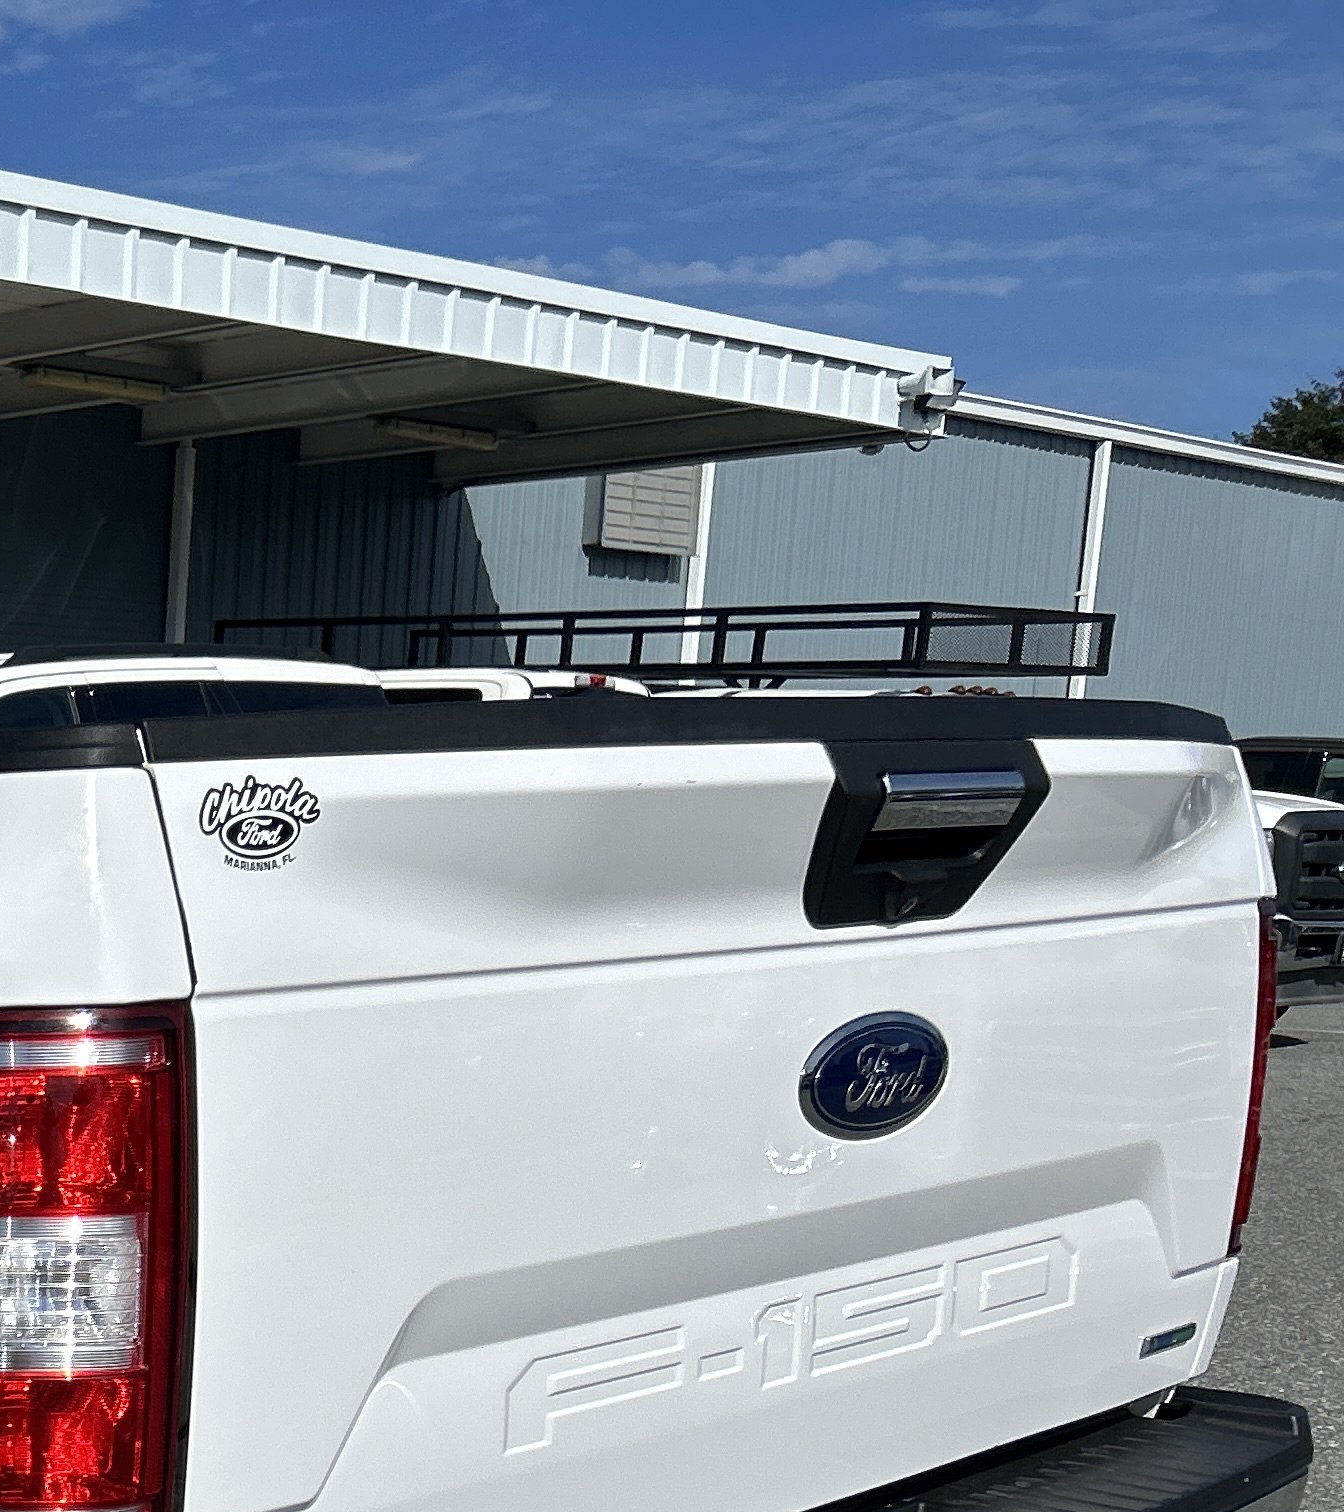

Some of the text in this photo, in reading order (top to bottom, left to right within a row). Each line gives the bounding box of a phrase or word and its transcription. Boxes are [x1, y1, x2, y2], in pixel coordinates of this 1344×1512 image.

[199, 775, 321, 836] Chipola
[237, 817, 284, 846] Ford
[223, 853, 297, 872] MARIANNA, FL
[845, 1042, 928, 1112] Ford
[504, 1236, 1080, 1455] F-150
